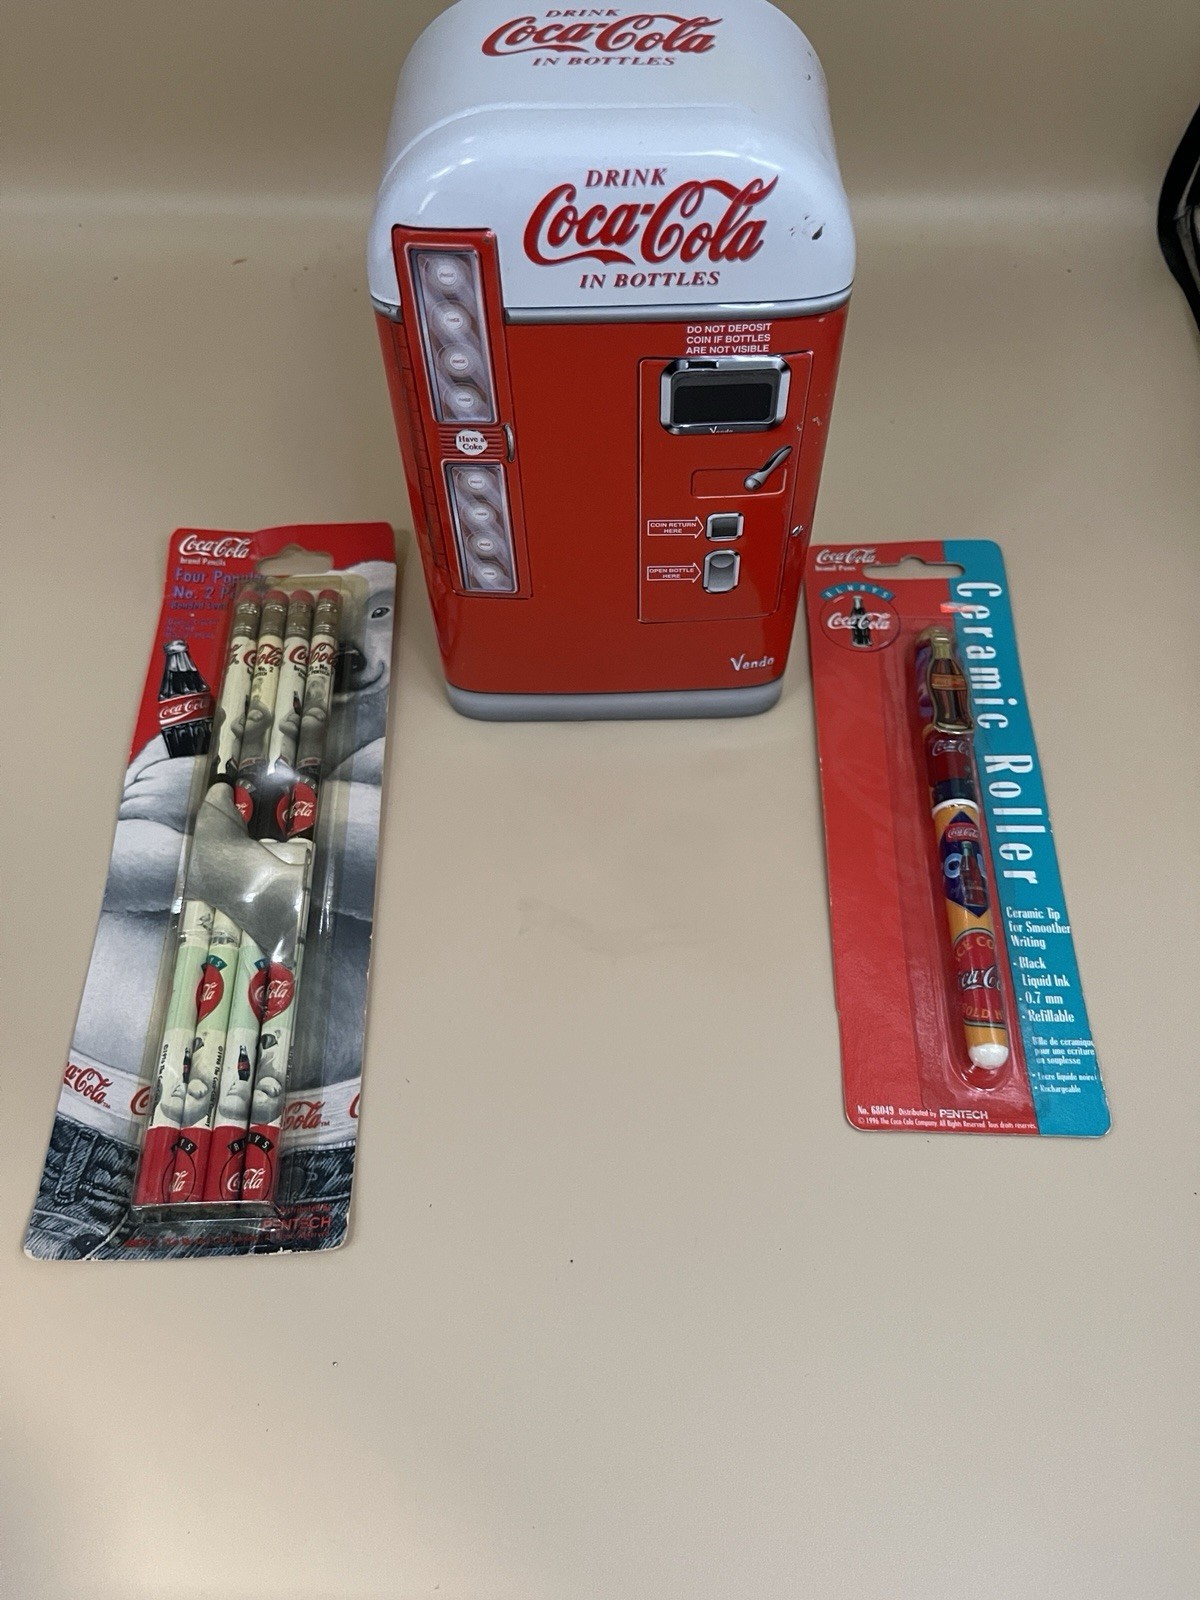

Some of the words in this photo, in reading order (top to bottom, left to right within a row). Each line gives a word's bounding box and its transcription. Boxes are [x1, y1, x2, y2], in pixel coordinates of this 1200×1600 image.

[545, 9, 620, 18] DRINK
[481, 13, 723, 57] Coca-Cola
[532, 57, 562, 66] IN
[566, 56, 676, 66] BOTTLES
[585, 168, 668, 188] DRINK
[523, 175, 779, 266] Coca-Cola
[579, 273, 609, 289] IN
[613, 271, 720, 289] BOTTLES
[686, 325, 702, 334] DO
[704, 324, 725, 334] NOT
[728, 322, 772, 333] DEPOSIT
[686, 335, 711, 344] COIN
[713, 335, 723, 344] IF
[725, 333, 771, 343] BOTTLES
[686, 346, 707, 354] ARE
[709, 345, 730, 354] NOT
[732, 344, 769, 353] VISIBLE
[458, 435, 479, 443] Have
[178, 534, 252, 558] Coca-Cola
[202, 558, 226, 566] Pencils
[174, 567, 205, 582] Four
[173, 586, 197, 599] No.
[204, 586, 214, 599] 2
[827, 612, 891, 630] Coca-Cola
[956, 581, 1018, 730] Ceramic
[730, 653, 775, 672] Vendo
[984, 754, 1046, 884] Roller
[1006, 906, 1044, 919] Ceramic
[1046, 907, 1060, 921] Tip
[1008, 921, 1023, 933] for
[1025, 921, 1071, 934] Smoother
[1011, 935, 1046, 950] Writing
[1019, 956, 1047, 969] Black
[1022, 973, 1052, 988] Liquid
[1054, 974, 1071, 987] Ink
[1025, 991, 1041, 1004] 0.7
[1045, 995, 1063, 1004] mm
[1028, 1009, 1075, 1022] Refillable
[1049, 1036, 1058, 1045] de
[1047, 1055, 1081, 1066] souplesse
[857, 1105, 870, 1115] No.
[871, 1105, 894, 1115] 68049
[898, 1108, 928, 1117] Distributed
[929, 1109, 937, 1118] by
[939, 1109, 988, 1119] PENTECH
[880, 1117, 889, 1125] The
[947, 1120, 962, 1128] Rights
